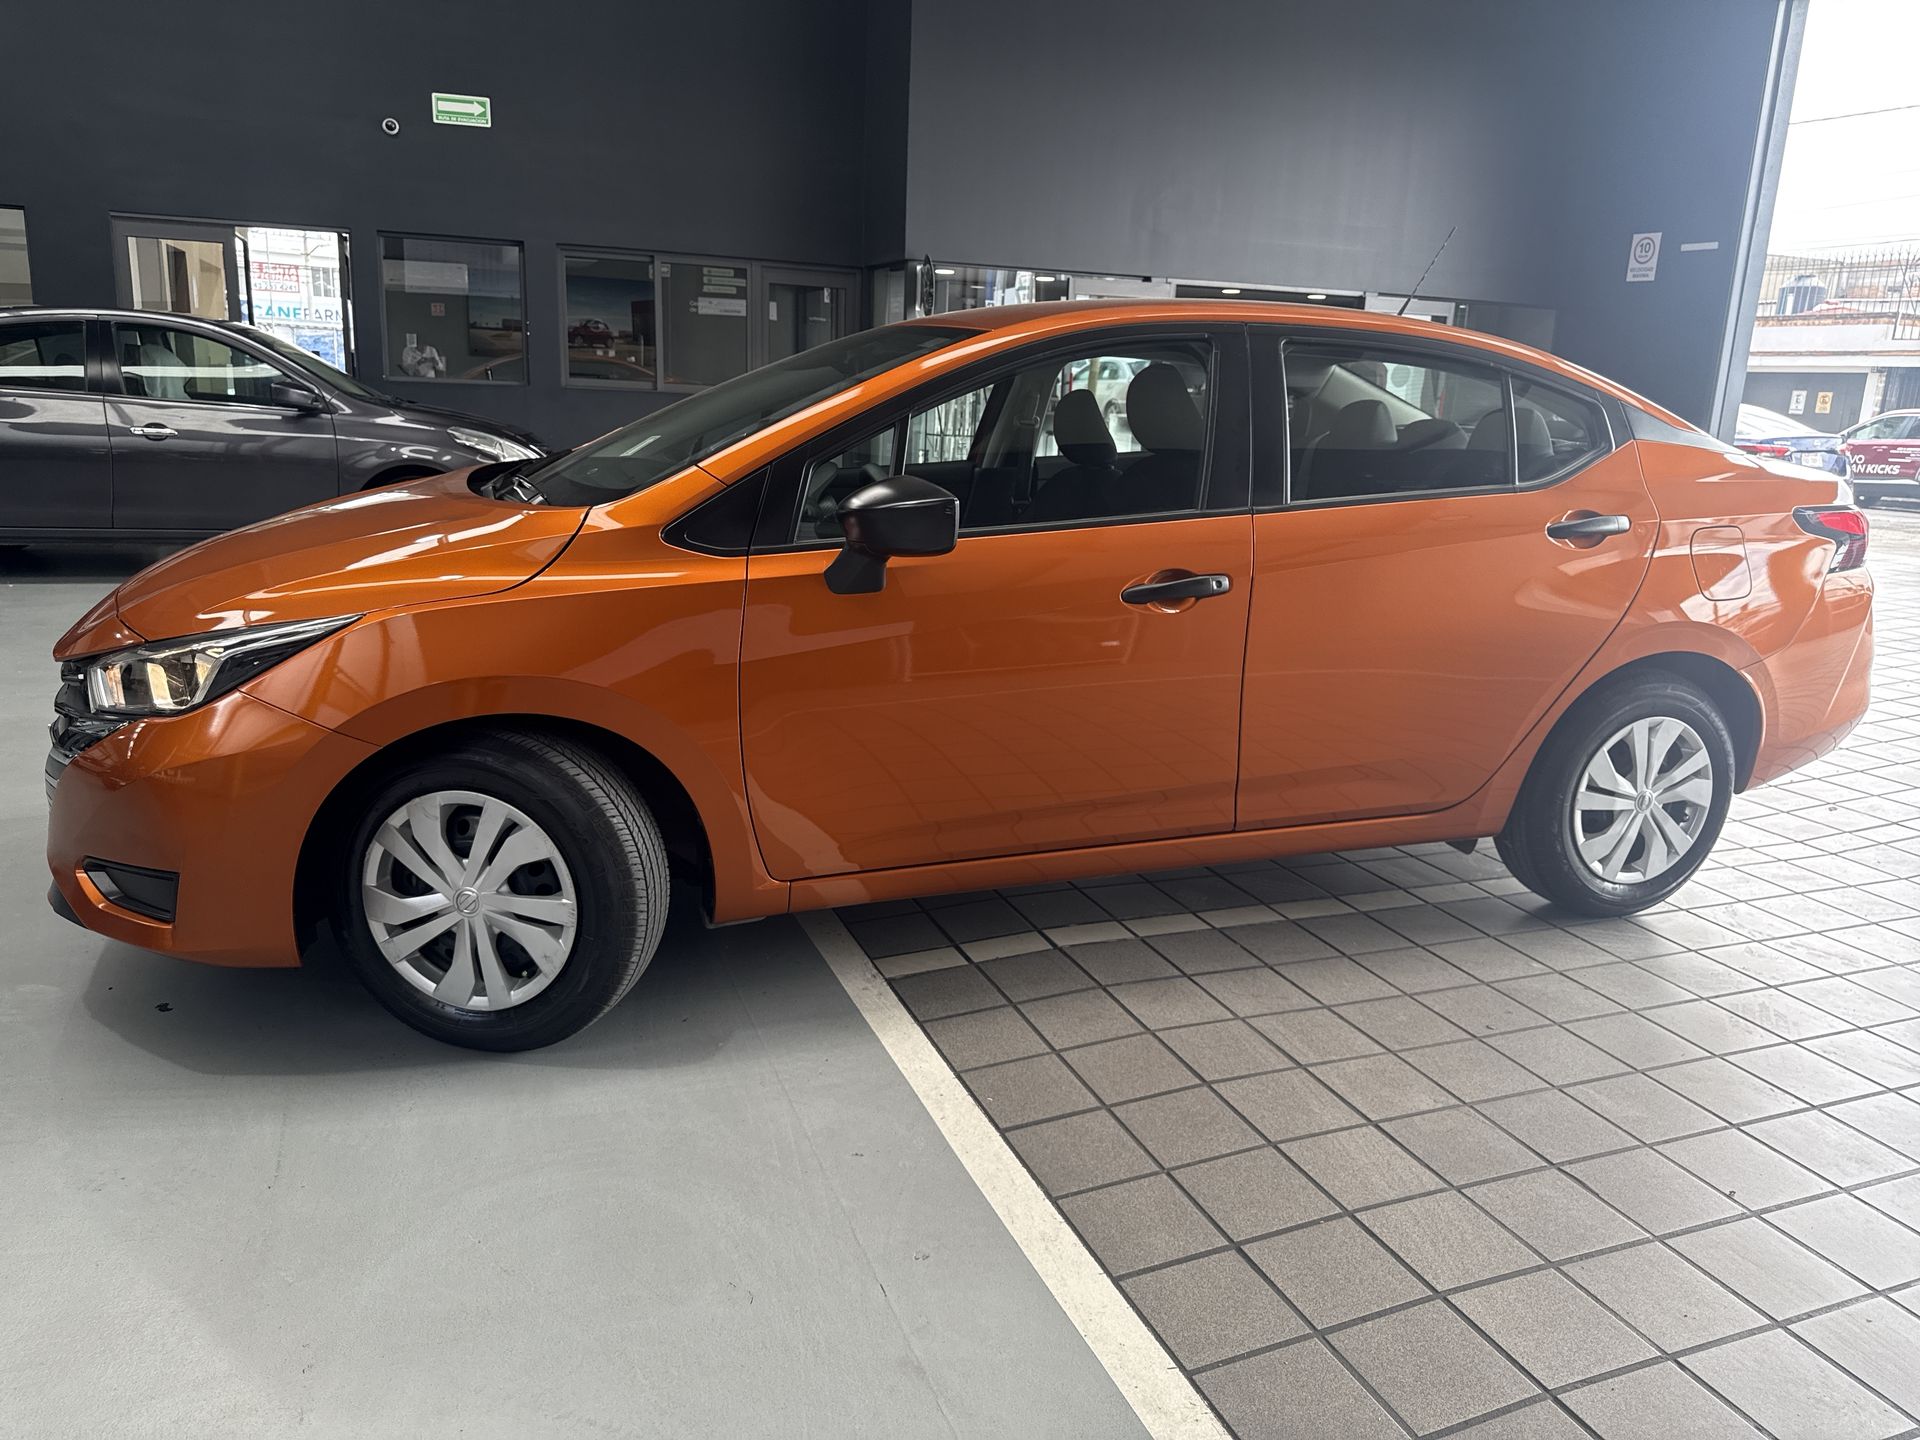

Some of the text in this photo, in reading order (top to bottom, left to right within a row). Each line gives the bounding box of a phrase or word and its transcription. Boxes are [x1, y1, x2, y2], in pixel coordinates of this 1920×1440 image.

[1639, 242, 1651, 253] 10
[1849, 454, 1865, 464] VO
[1851, 464, 1901, 475] AN KICKS
